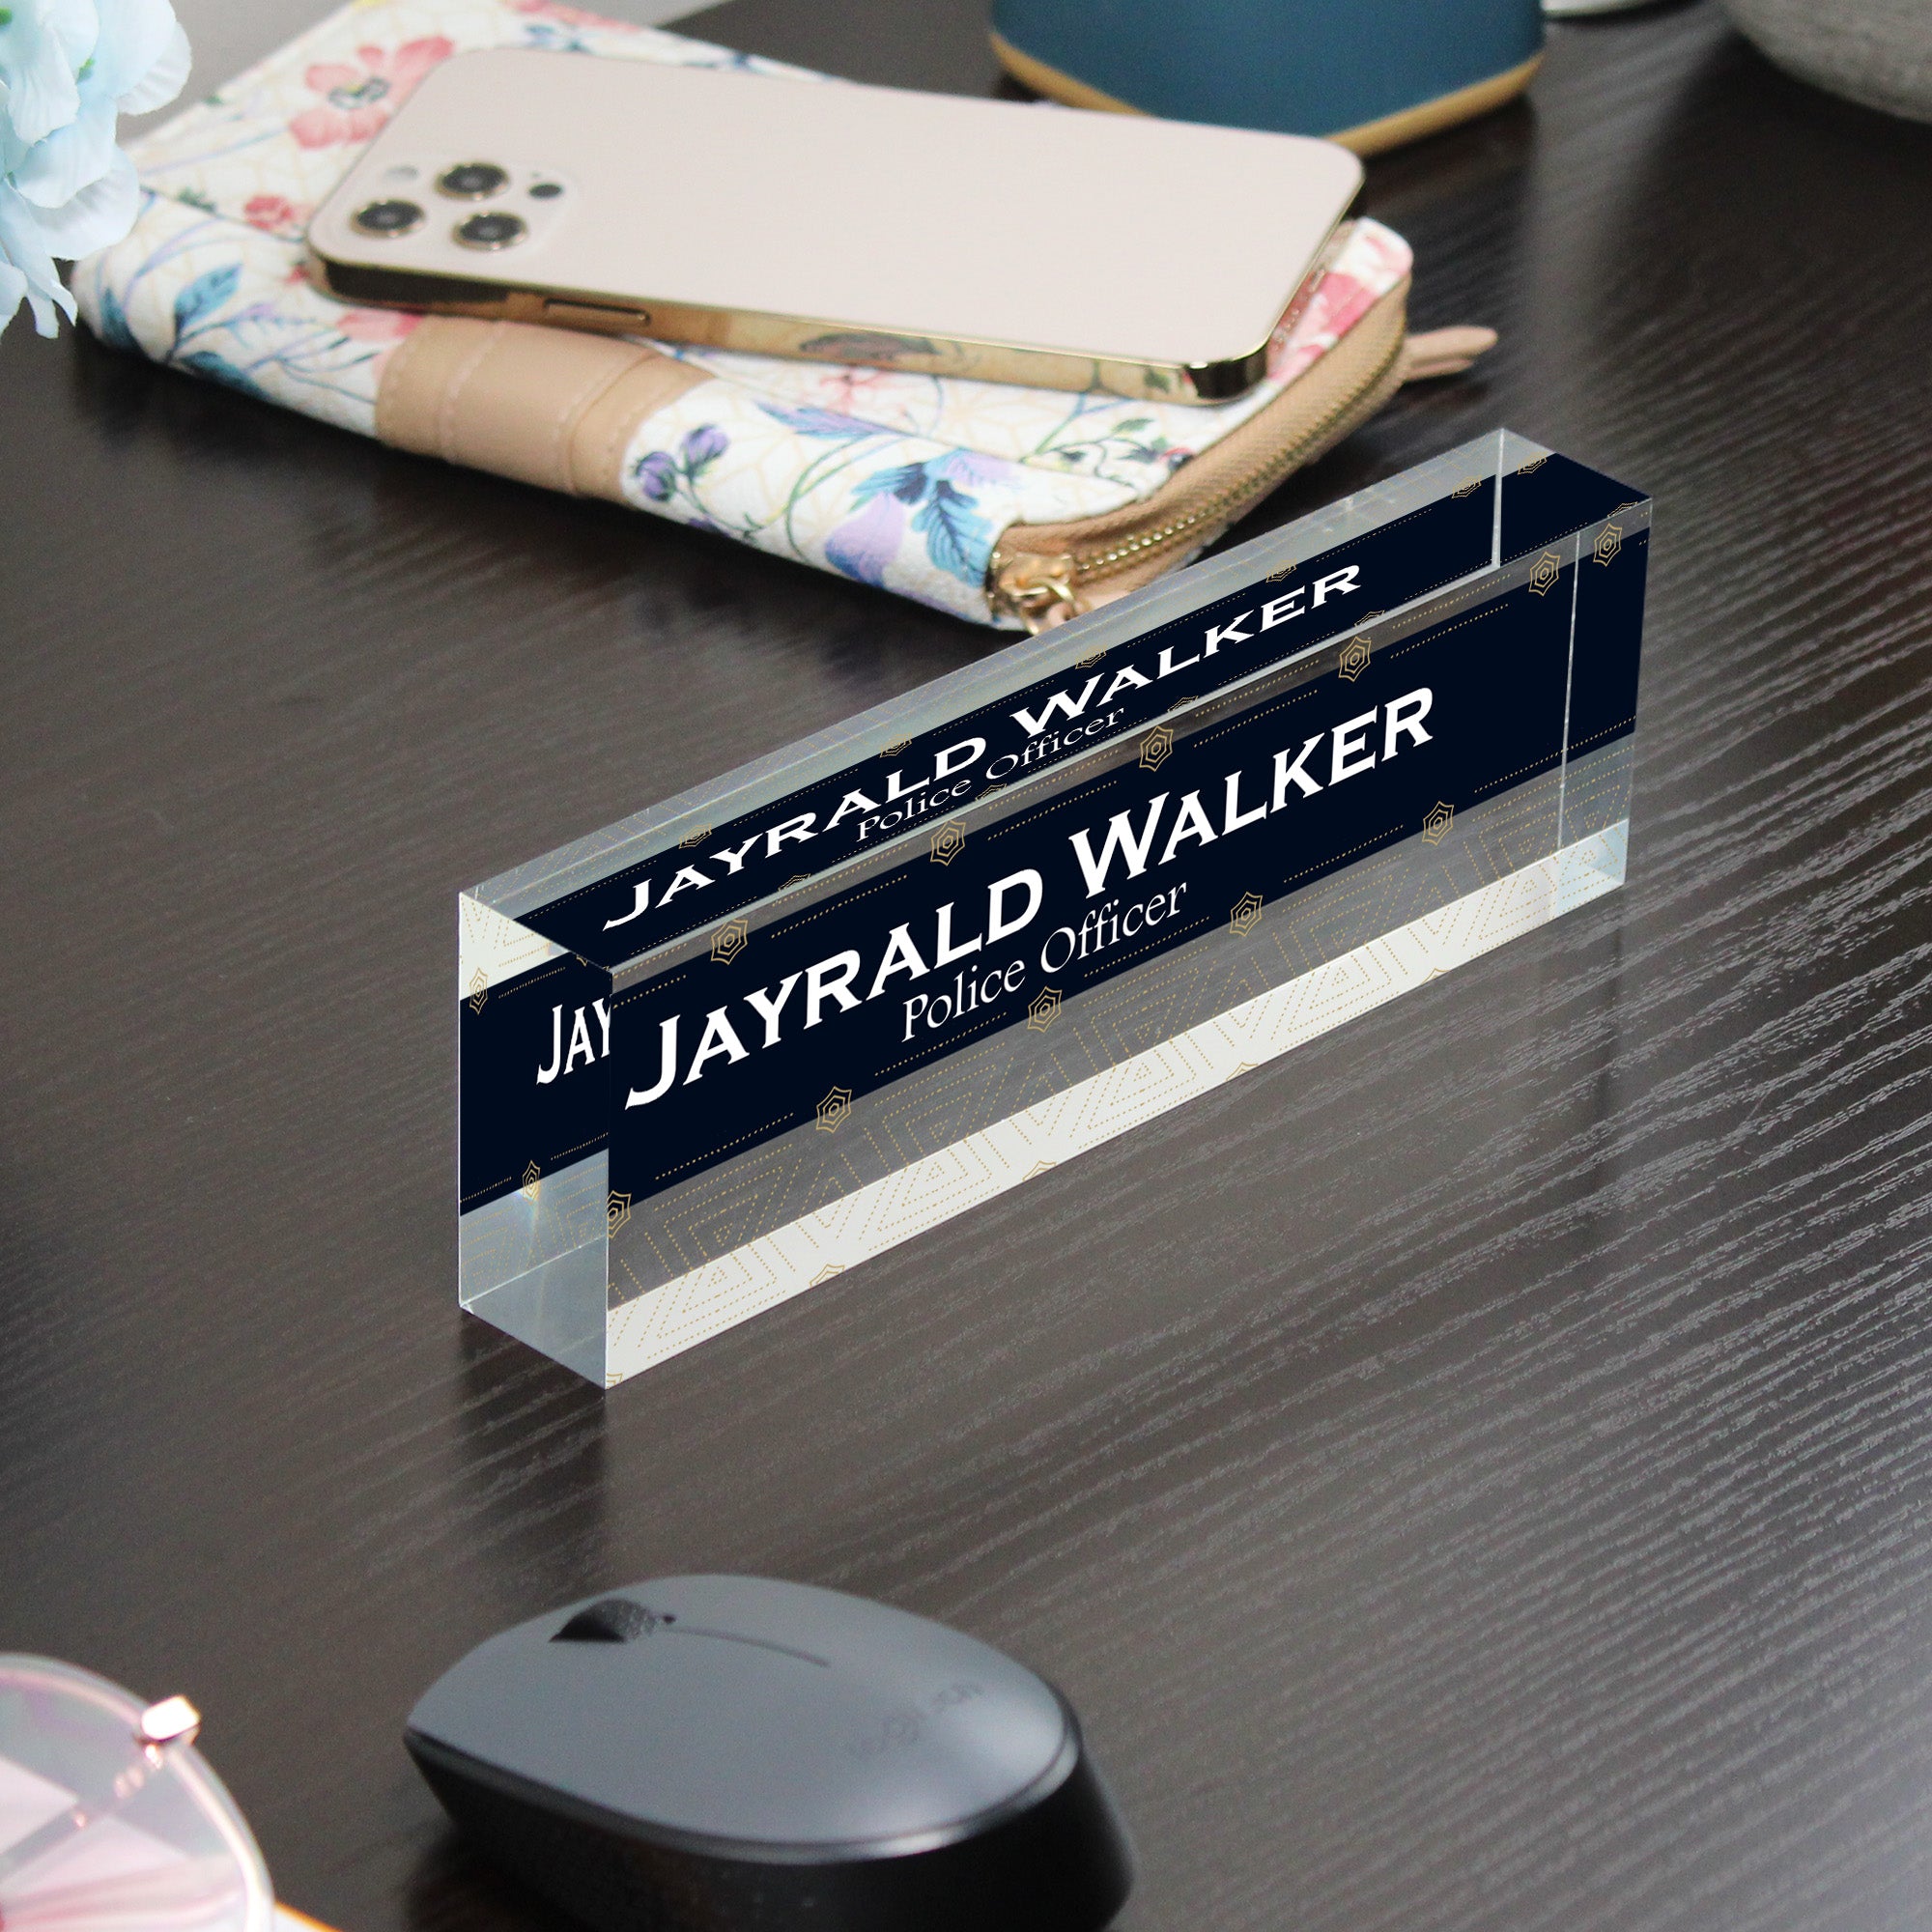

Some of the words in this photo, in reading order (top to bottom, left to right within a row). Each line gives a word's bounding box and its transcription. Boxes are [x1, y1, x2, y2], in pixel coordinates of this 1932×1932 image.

[602, 737, 986, 932] JAYRALD
[1009, 564, 1361, 739] WALKER
[856, 779, 973, 843] Police
[985, 707, 1124, 781] Officer
[624, 868, 1043, 1111] JAYRALD
[1067, 687, 1434, 899] WALKER
[901, 959, 1026, 1043] Police
[1038, 882, 1189, 974] Officer
[536, 997, 611, 1086] JAY
